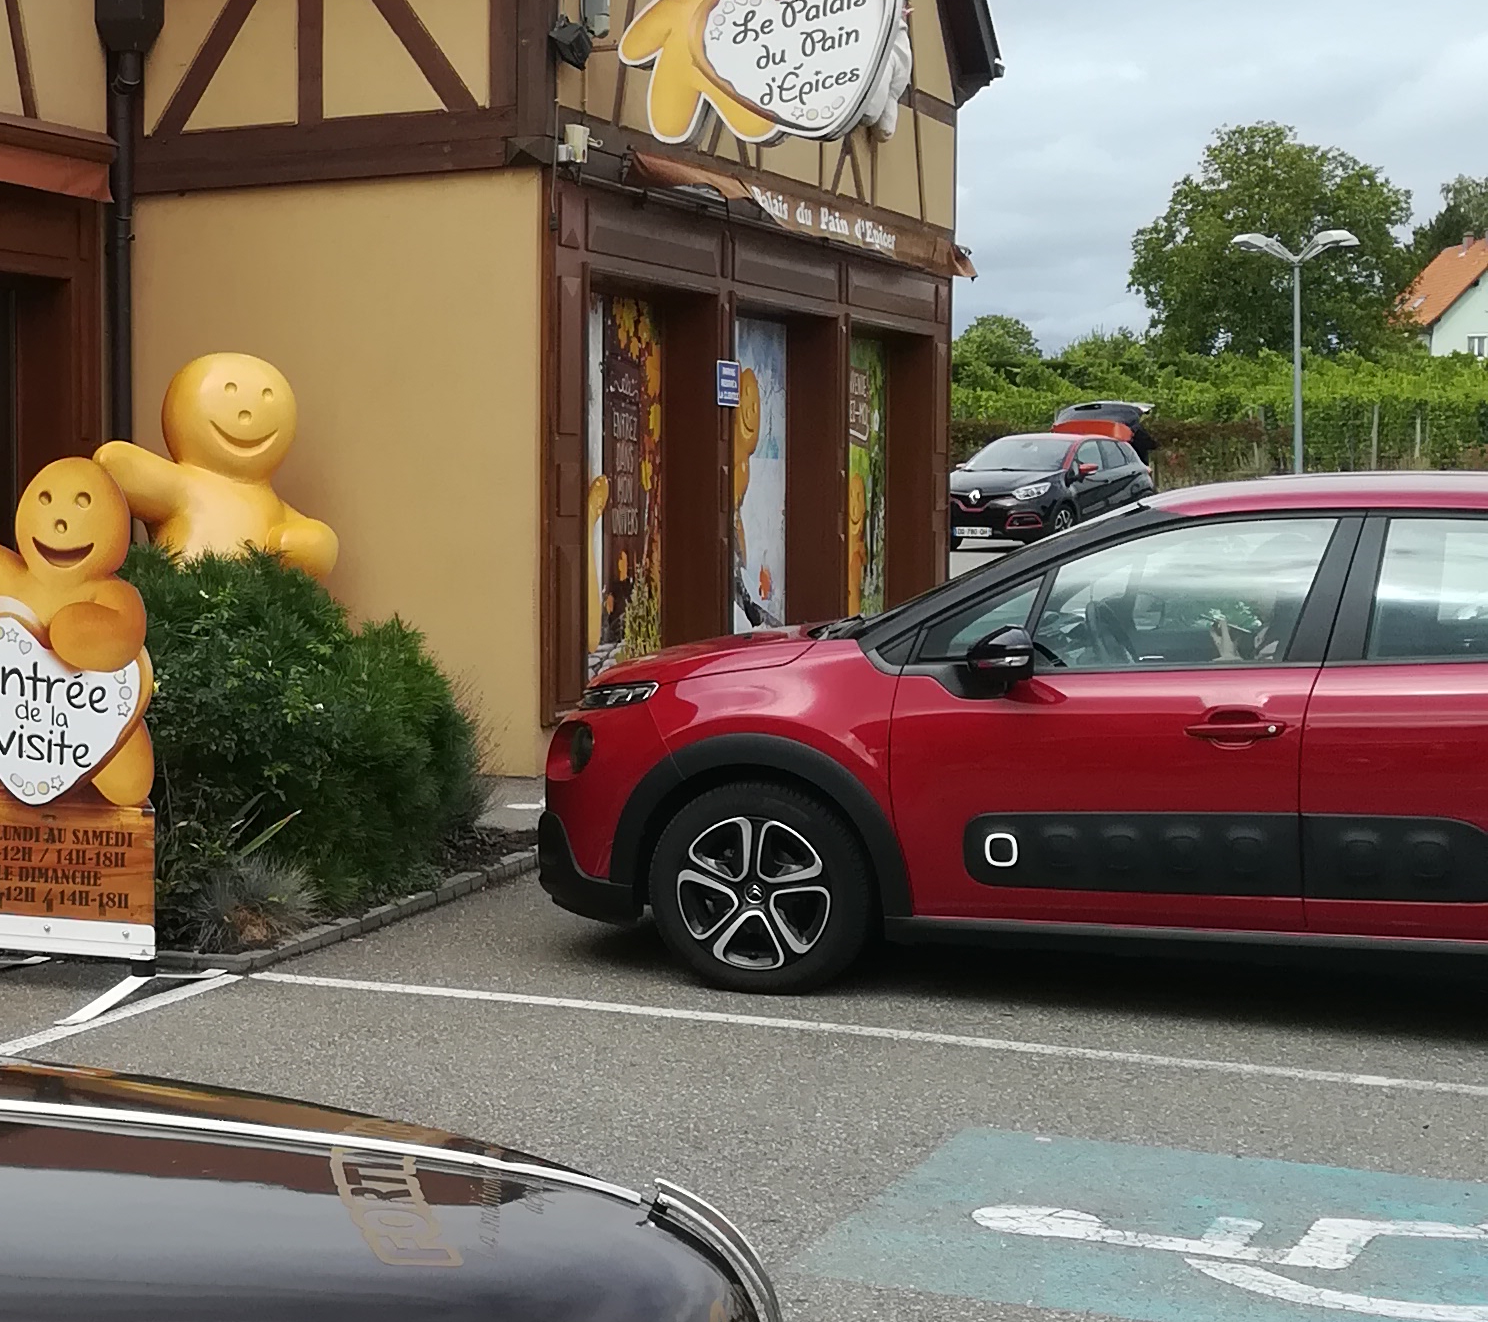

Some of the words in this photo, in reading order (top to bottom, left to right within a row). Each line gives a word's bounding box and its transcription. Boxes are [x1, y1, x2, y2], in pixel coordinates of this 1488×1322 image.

[732, 9, 774, 45] Le
[755, 44, 787, 70] du
[800, 25, 861, 58] Pain
[751, 185, 789, 221] Palais
[795, 201, 813, 226] du
[819, 207, 850, 236] Pain
[613, 410, 638, 442] ENTREZ
[15, 699, 42, 723] de
[51, 705, 69, 729] la
[44, 828, 67, 845] AU
[72, 828, 134, 848] SAMEDI
[39, 847, 50, 864] /
[56, 848, 127, 868] 14H-18H
[18, 866, 102, 887] DIMANCHE
